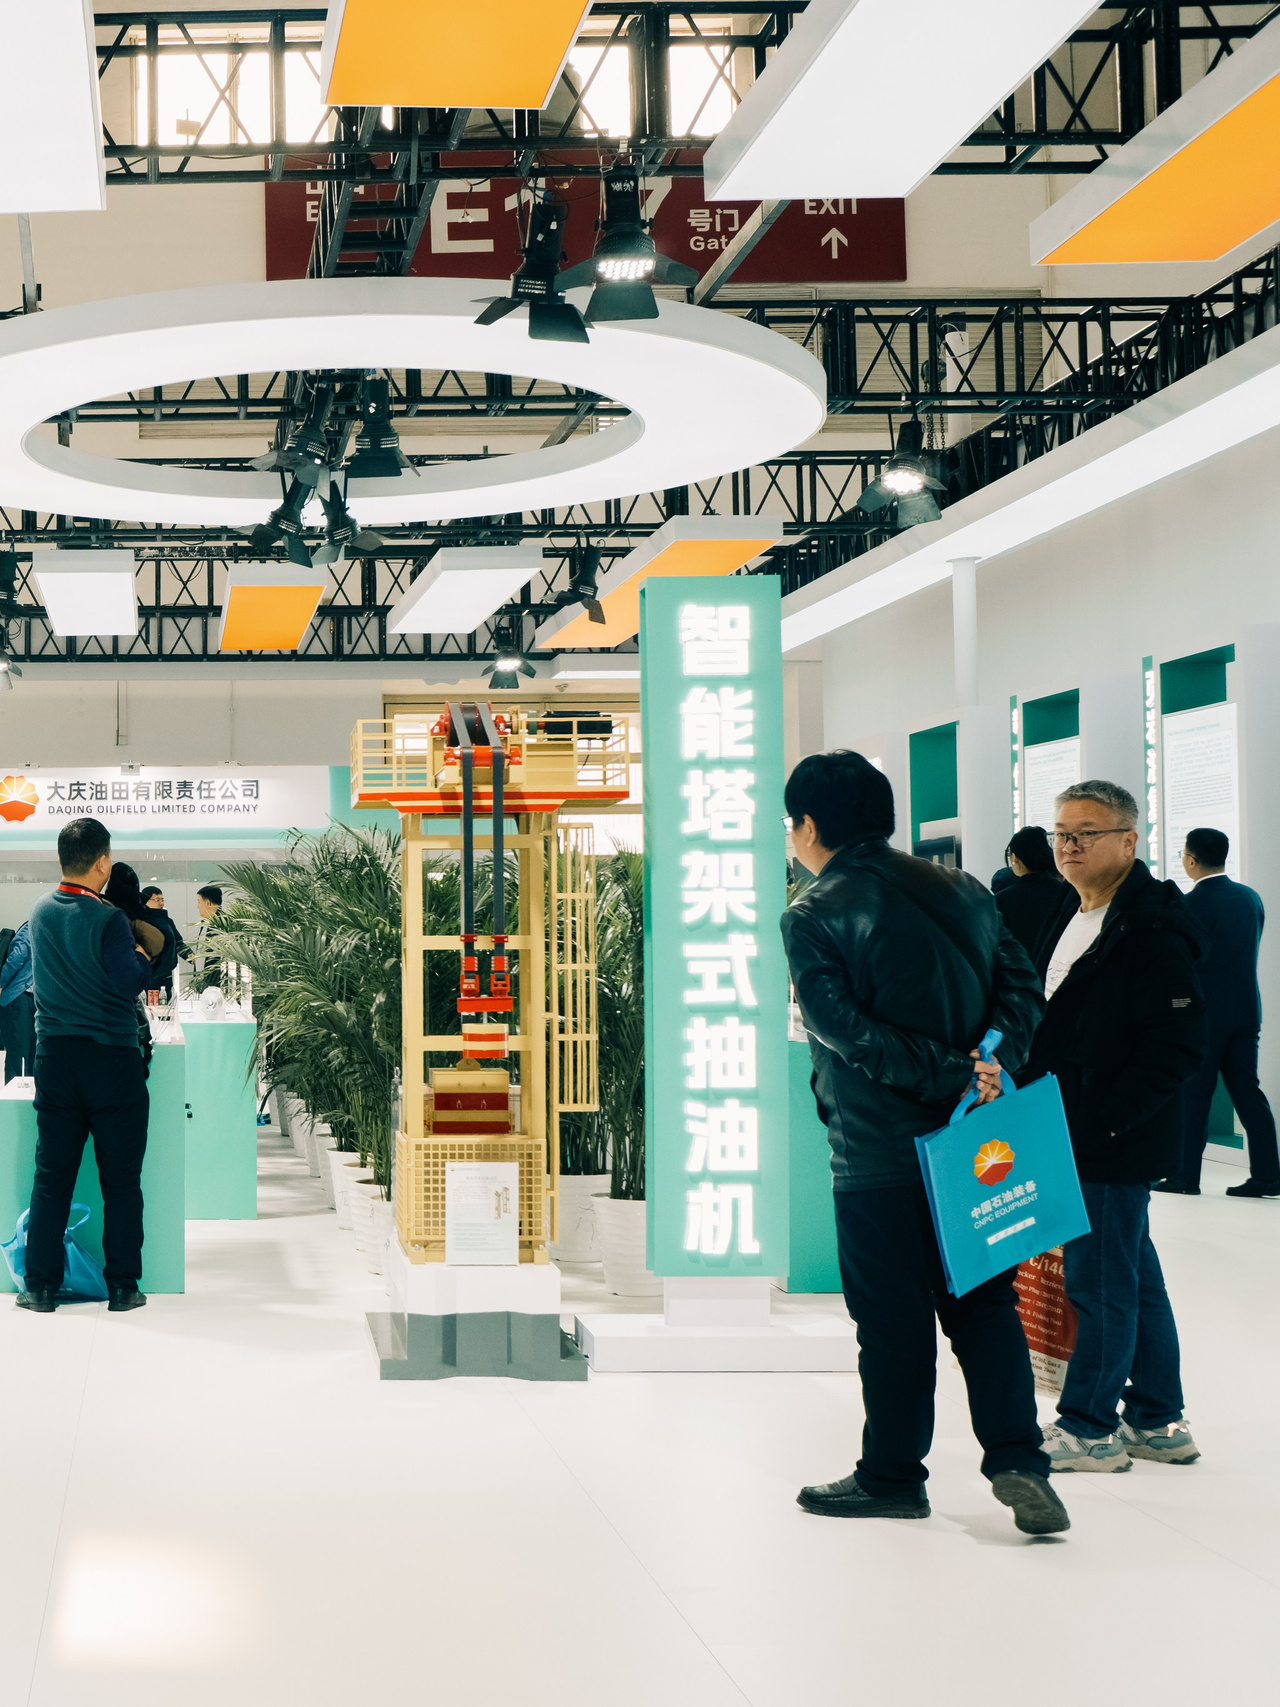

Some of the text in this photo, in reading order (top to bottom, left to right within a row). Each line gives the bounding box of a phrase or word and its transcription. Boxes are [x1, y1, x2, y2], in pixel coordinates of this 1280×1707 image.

[687, 209, 740, 232] 号门
[689, 235, 734, 251] Gat
[46, 779, 260, 801] 大庆油田有限责任公司
[48, 803, 258, 815] DAQING OILFIELD LIMITED COMPANY
[680, 604, 760, 1255] 智能塔架式抽油机
[971, 1180, 1036, 1219] 中国石油装备
[973, 1193, 1038, 1230] CNPC EQUIPMENT
